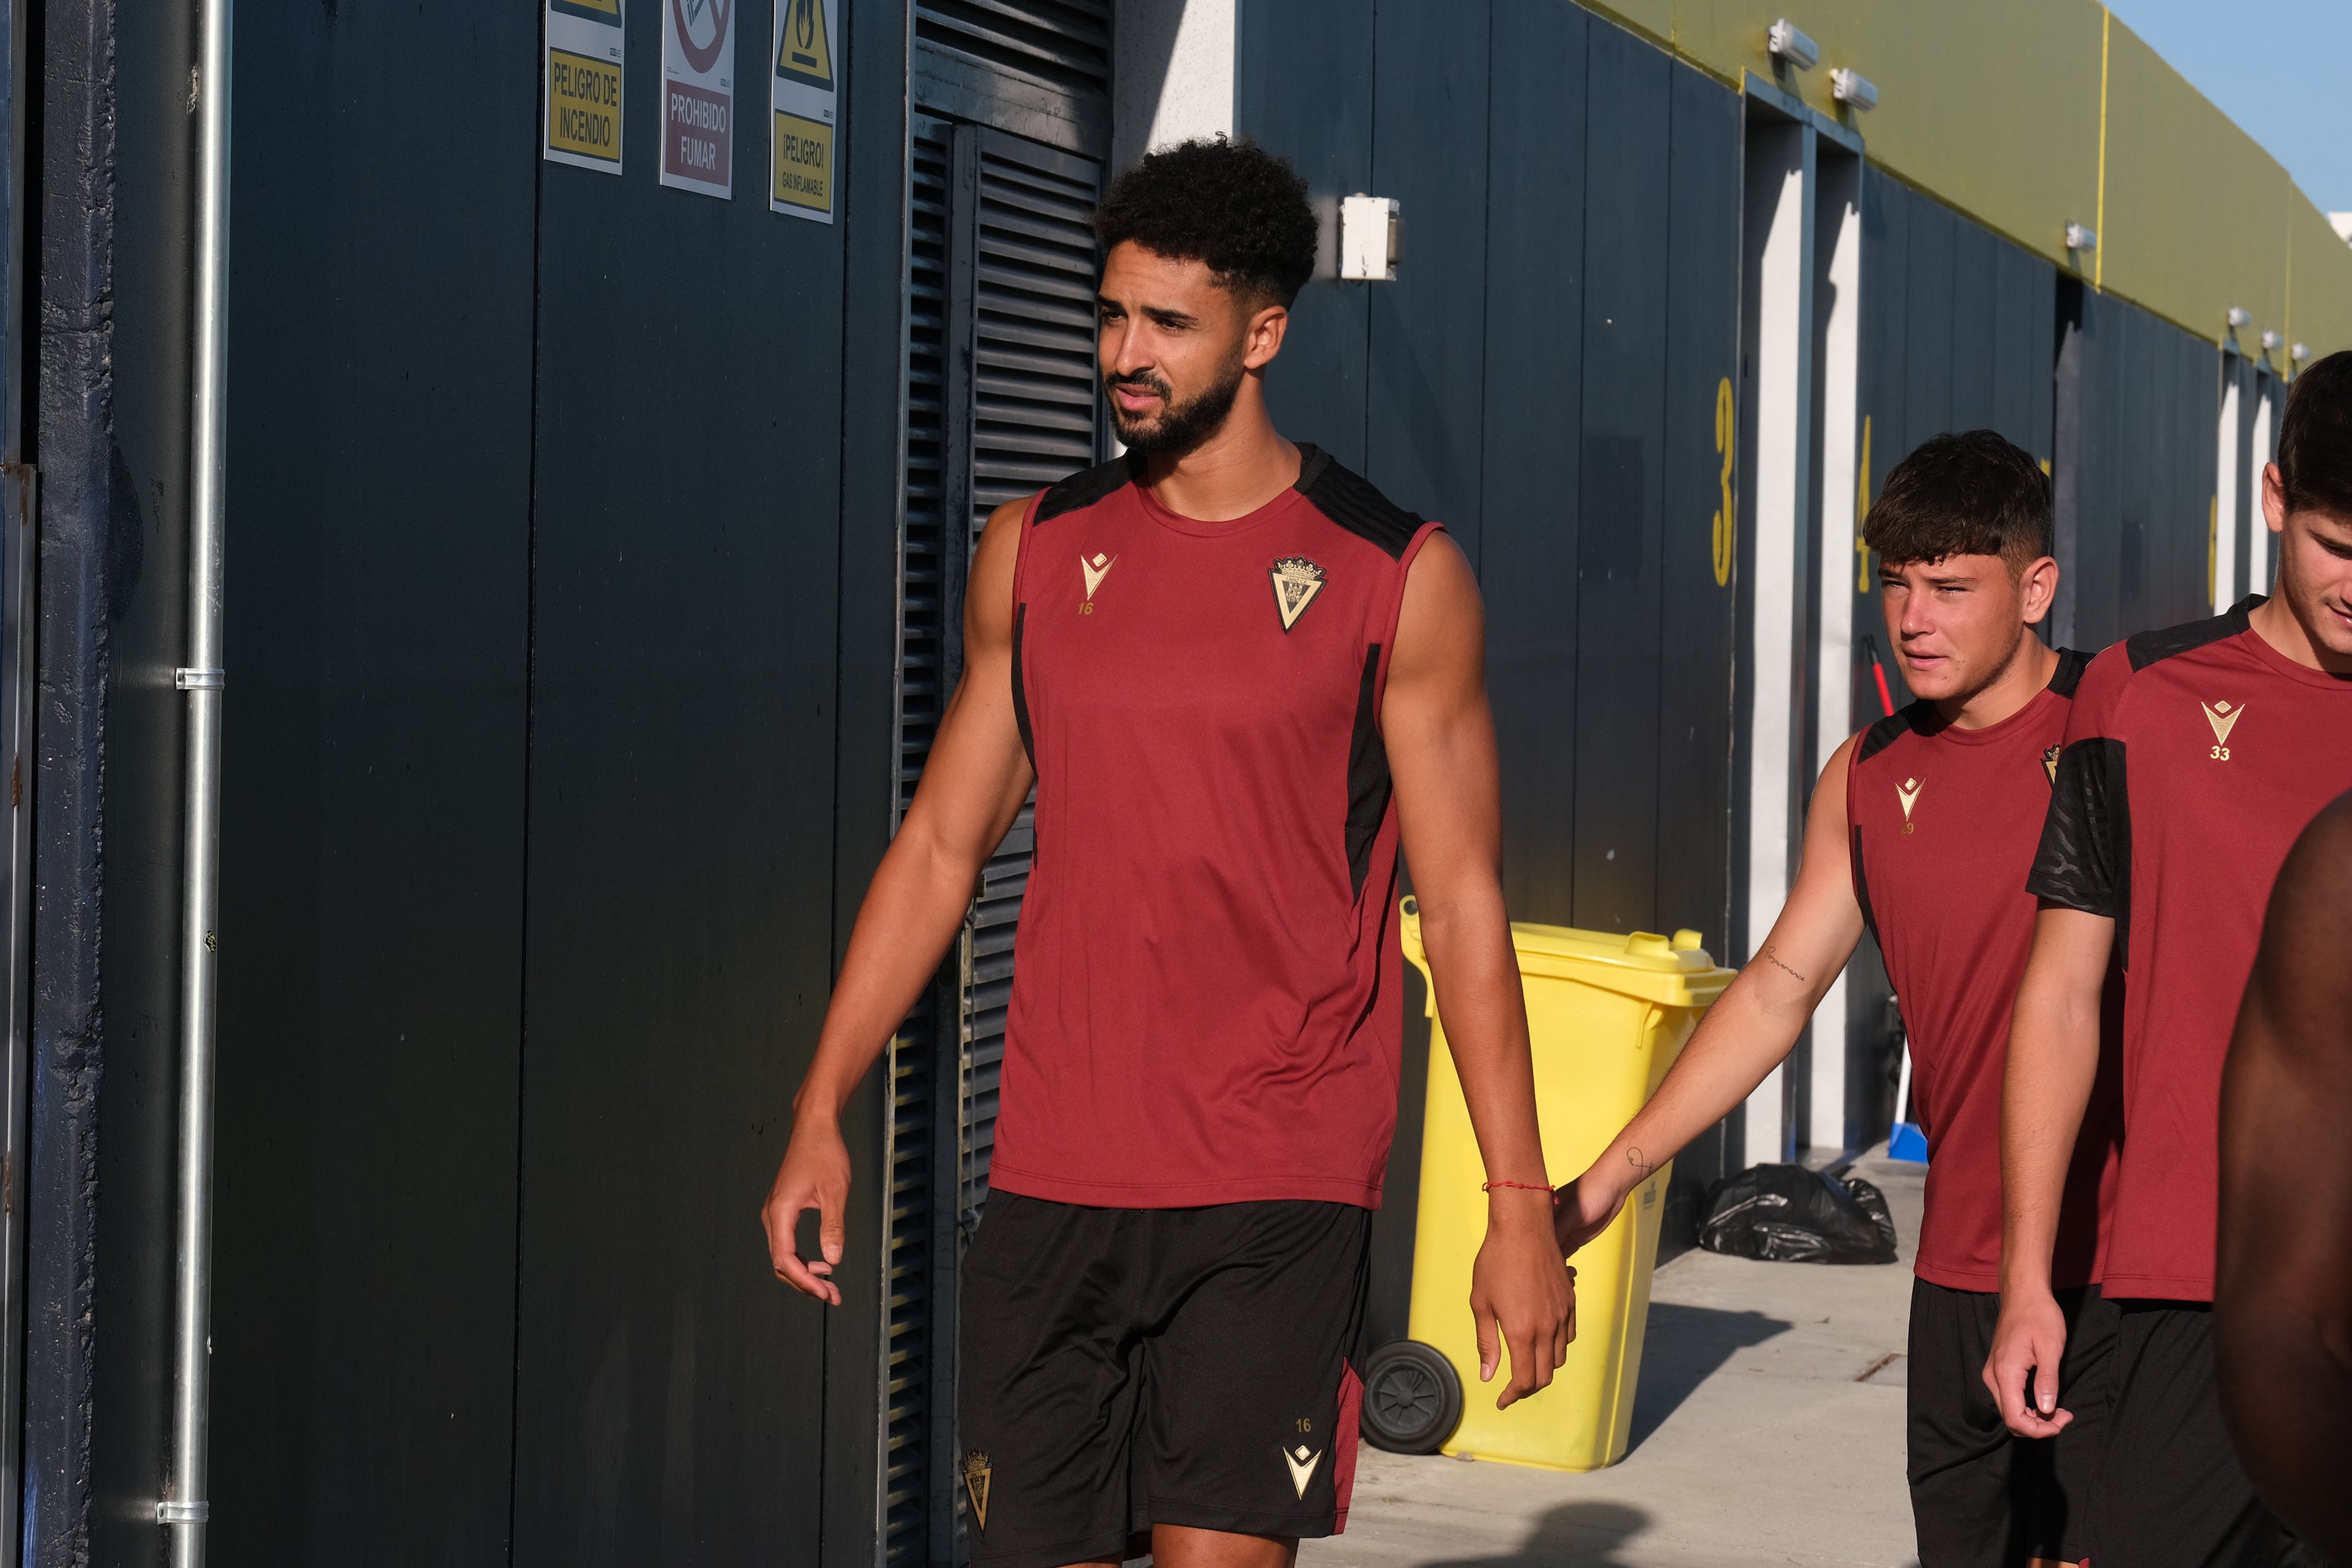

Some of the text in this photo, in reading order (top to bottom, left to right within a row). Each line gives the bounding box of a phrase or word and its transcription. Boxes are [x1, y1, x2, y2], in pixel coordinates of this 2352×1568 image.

[554, 62, 617, 107] PELIGRO DE
[560, 106, 611, 148] INCENDIO
[671, 92, 727, 134] PROHIBIDO
[680, 135, 716, 171] FUMAR
[783, 133, 824, 169] ¡PELIGRO!
[782, 171, 823, 197] GAS INFLAMABLE
[1712, 377, 1735, 587] 3
[1079, 601, 1094, 615] 16
[2209, 745, 2230, 762] 33
[1296, 1417, 1312, 1433] 16
